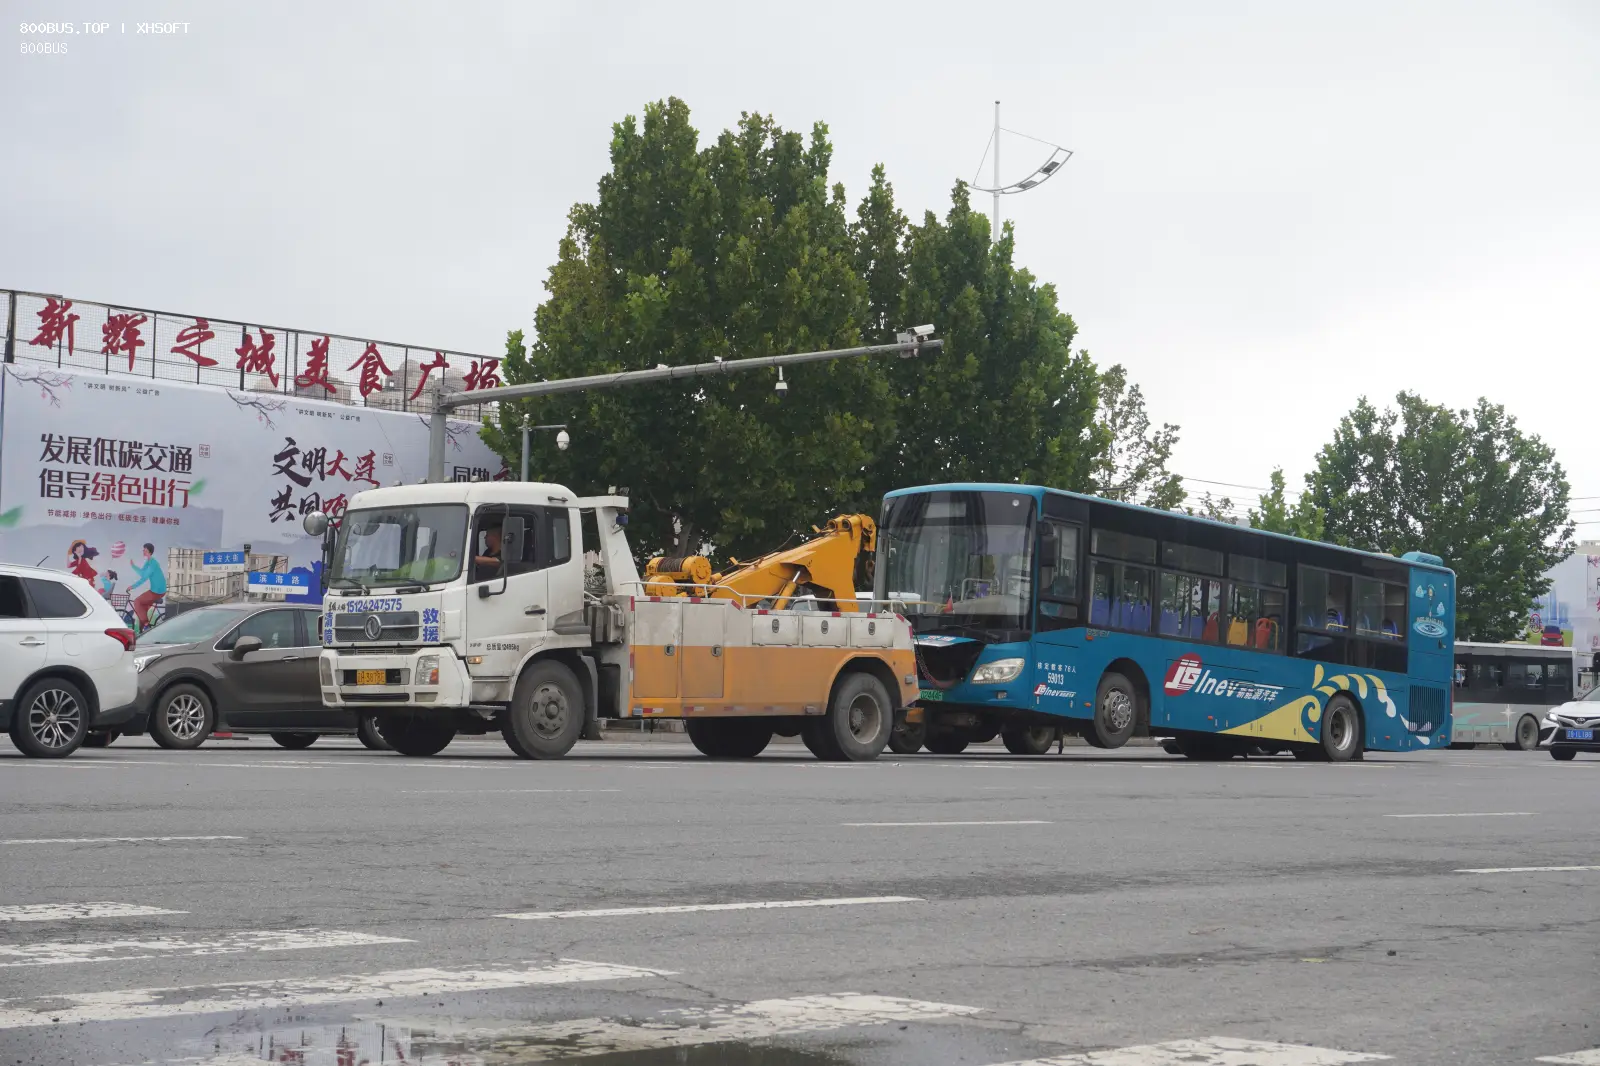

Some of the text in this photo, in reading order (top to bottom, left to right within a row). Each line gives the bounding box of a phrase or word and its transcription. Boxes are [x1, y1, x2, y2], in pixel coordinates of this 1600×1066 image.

[38, 432, 193, 475] 发展低碳交通
[271, 436, 381, 488] 文明大连
[38, 467, 191, 509] 倡导绿色出行
[47, 508, 77, 519] 节能减排
[82, 511, 113, 521] 绿色出行
[258, 573, 300, 585] 滨海路
[346, 597, 403, 614] 15124247575
[422, 607, 440, 643] 救援
[1047, 672, 1065, 685] 59013
